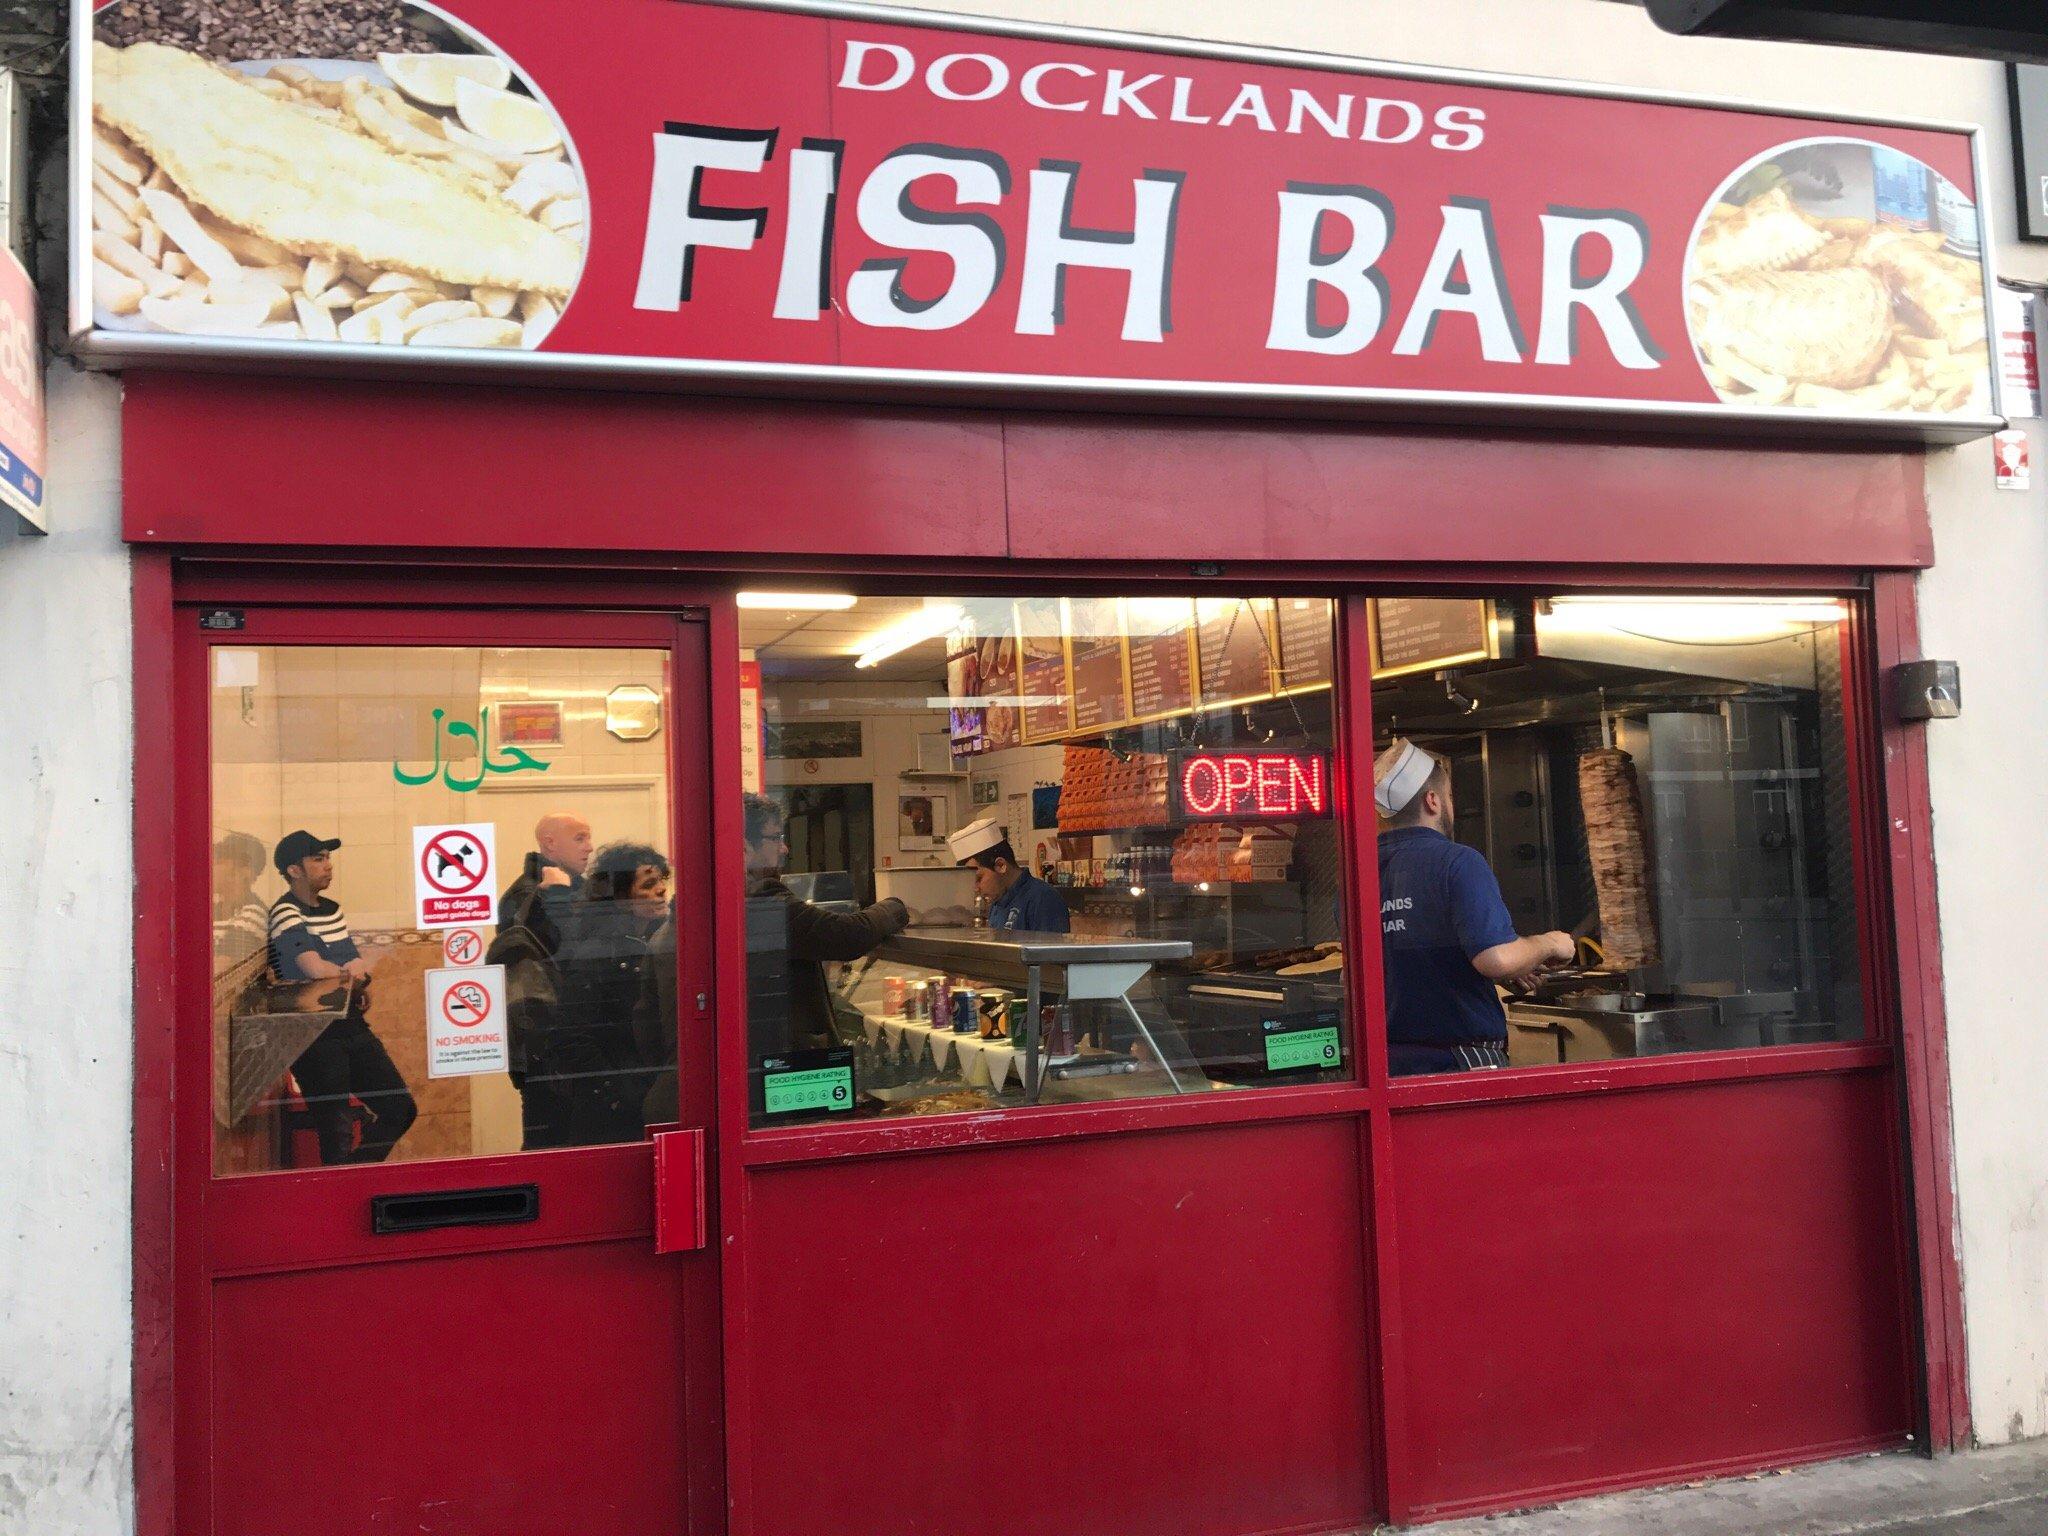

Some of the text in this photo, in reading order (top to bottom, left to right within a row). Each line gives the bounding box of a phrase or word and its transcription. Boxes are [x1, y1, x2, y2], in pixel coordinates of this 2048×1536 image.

[837, 40, 1487, 152] DOCKLANDS
[633, 124, 1665, 369] FISH BAR
[393, 706, 551, 792] حلال
[1182, 756, 1323, 815] OPEN
[433, 899, 480, 911] No dogs
[449, 910, 471, 920] guide
[471, 909, 490, 918] dogs
[436, 1036, 451, 1047] NO
[1287, 1033, 1312, 1043] HYGIENE
[1313, 1030, 1334, 1039] RATING
[1325, 1046, 1333, 1057] 5
[769, 1070, 846, 1085] FOOD HYGIENE RATING
[835, 1087, 844, 1099] 5
